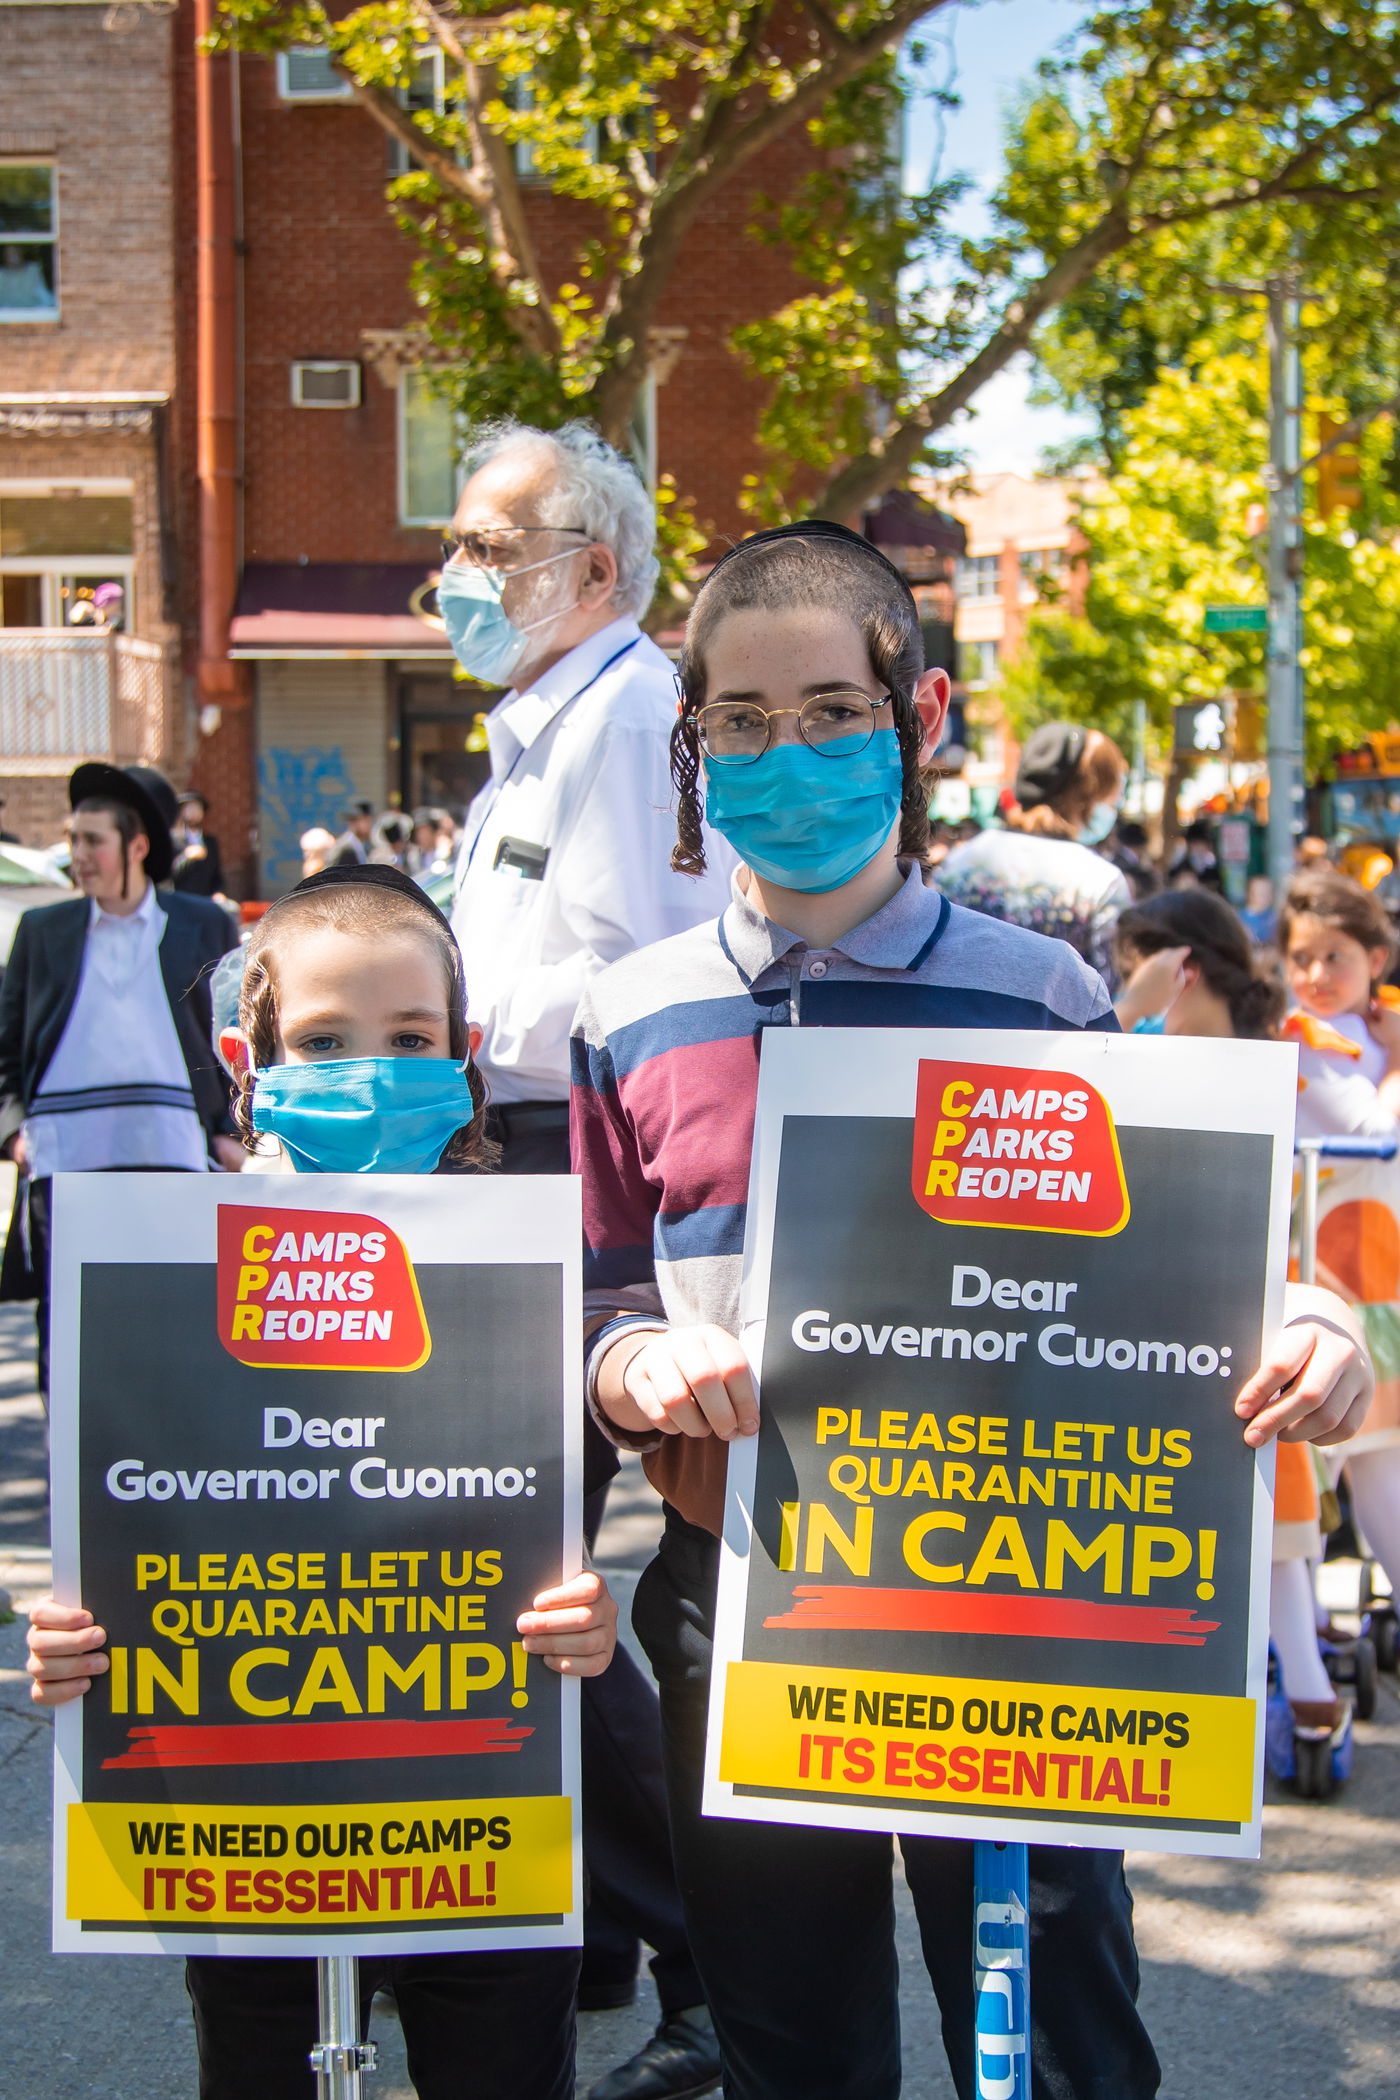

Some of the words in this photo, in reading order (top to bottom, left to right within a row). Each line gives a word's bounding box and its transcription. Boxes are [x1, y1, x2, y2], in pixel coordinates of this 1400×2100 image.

[940, 1080, 1089, 1122] CAMPS
[932, 1121, 1074, 1161] PARKS
[924, 1160, 1092, 1203] REOPEN
[242, 1225, 386, 1263] CAMPS
[237, 1266, 374, 1301] PARKS
[951, 1264, 1078, 1312] Dear
[232, 1304, 393, 1341] REOPEN
[791, 1310, 1027, 1363] Governor
[1037, 1324, 1233, 1377] Cuomo:
[263, 1408, 385, 1448] Dear
[815, 1406, 1009, 1457] PLEASE
[1022, 1419, 1117, 1463] LET
[1126, 1425, 1193, 1468] US
[106, 1459, 339, 1501] Governor
[349, 1457, 537, 1498] Cuomo:
[828, 1455, 1174, 1515] QUARANTINE
[136, 1553, 326, 1591] PLEASE
[341, 1551, 429, 1588] LET
[440, 1550, 504, 1587] US
[778, 1502, 875, 1578] IN
[902, 1510, 1217, 1601] CAMP!
[152, 1595, 487, 1645] QUARANTINE
[110, 1647, 200, 1716] IN
[229, 1642, 529, 1717] CAMP!
[787, 1685, 846, 1723] WE
[854, 1690, 954, 1732] NEED
[961, 1698, 1043, 1739] OUR
[1050, 1705, 1190, 1749] CAMPS
[798, 1733, 876, 1783] ITS
[884, 1741, 1172, 1807] ESSENTIAL!
[128, 1822, 186, 1855] WE
[192, 1822, 289, 1857] NEED
[295, 1821, 374, 1857] OUR
[379, 1816, 512, 1854] CAMPS
[143, 1868, 217, 1913] ITS
[225, 1861, 497, 1914] ESSENTIAL!
